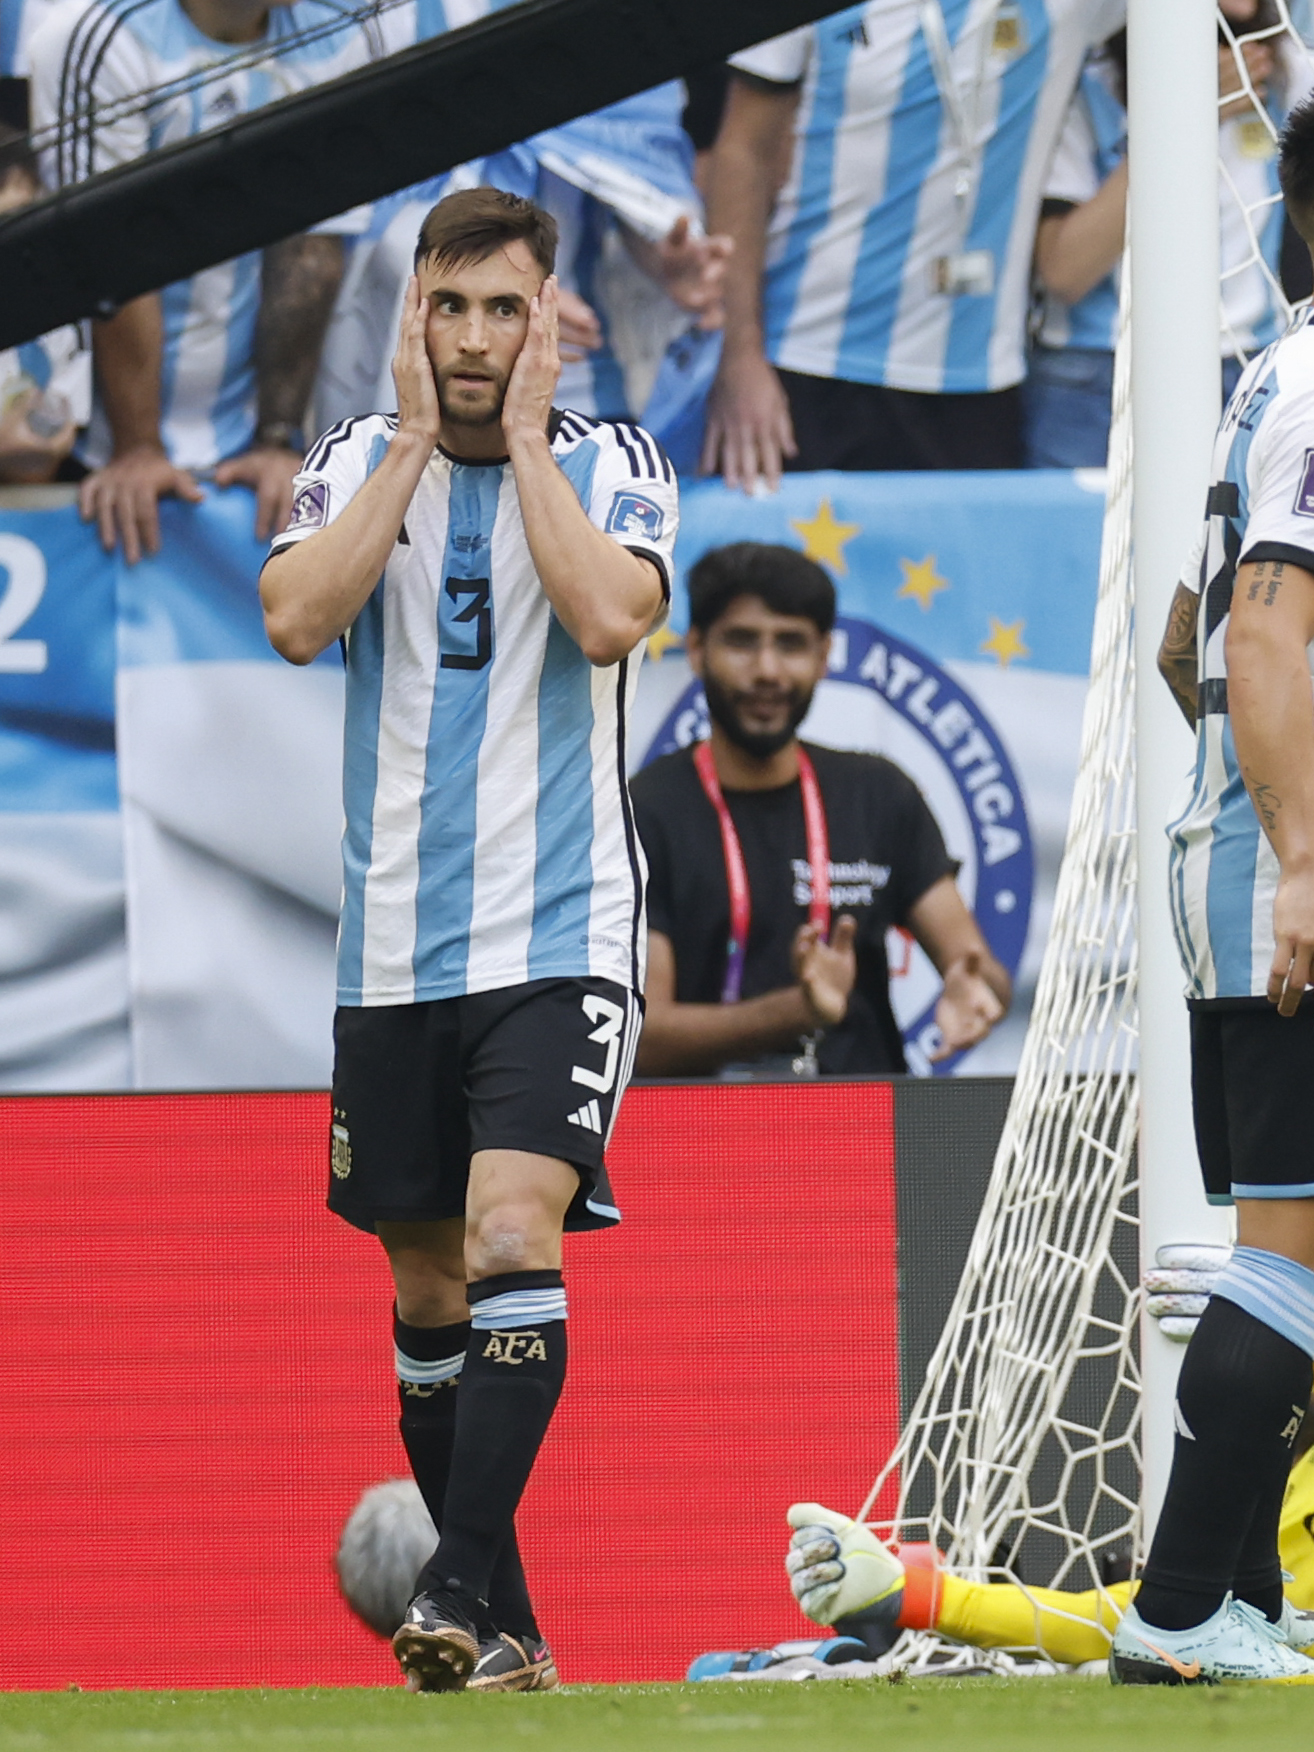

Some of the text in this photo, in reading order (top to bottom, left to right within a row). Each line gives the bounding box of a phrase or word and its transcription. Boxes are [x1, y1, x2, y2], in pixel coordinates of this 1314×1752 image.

[440, 577, 491, 670] 3
[858, 642, 1022, 867] ATLETICA
[791, 858, 892, 890] Tenology
[571, 994, 625, 1095] 3
[481, 1329, 548, 1365] AFA
